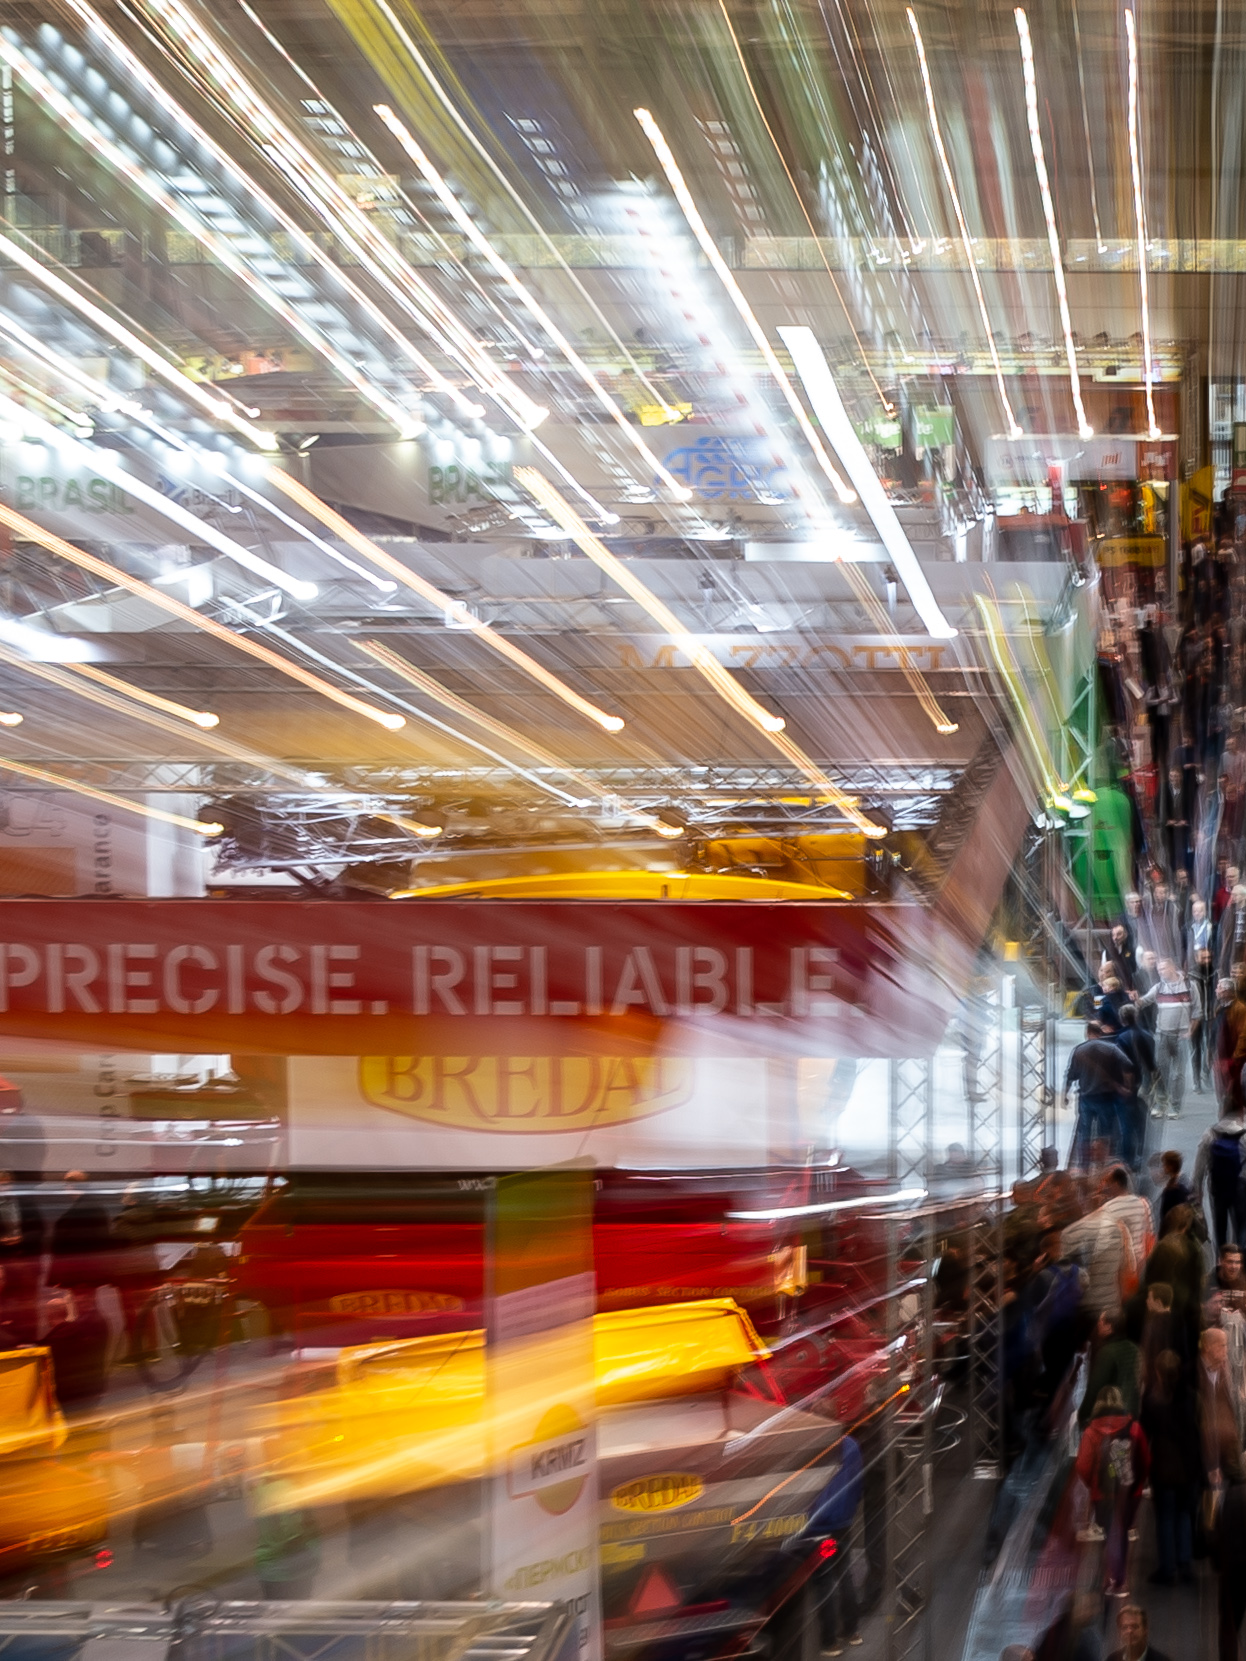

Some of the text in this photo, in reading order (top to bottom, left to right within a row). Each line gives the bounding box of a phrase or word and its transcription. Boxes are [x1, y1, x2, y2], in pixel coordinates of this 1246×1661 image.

[616, 645, 946, 669] MZZOTTI
[0, 943, 869, 1017] PRECISE. RELIABLE.
[380, 1055, 683, 1124] BREDAL
